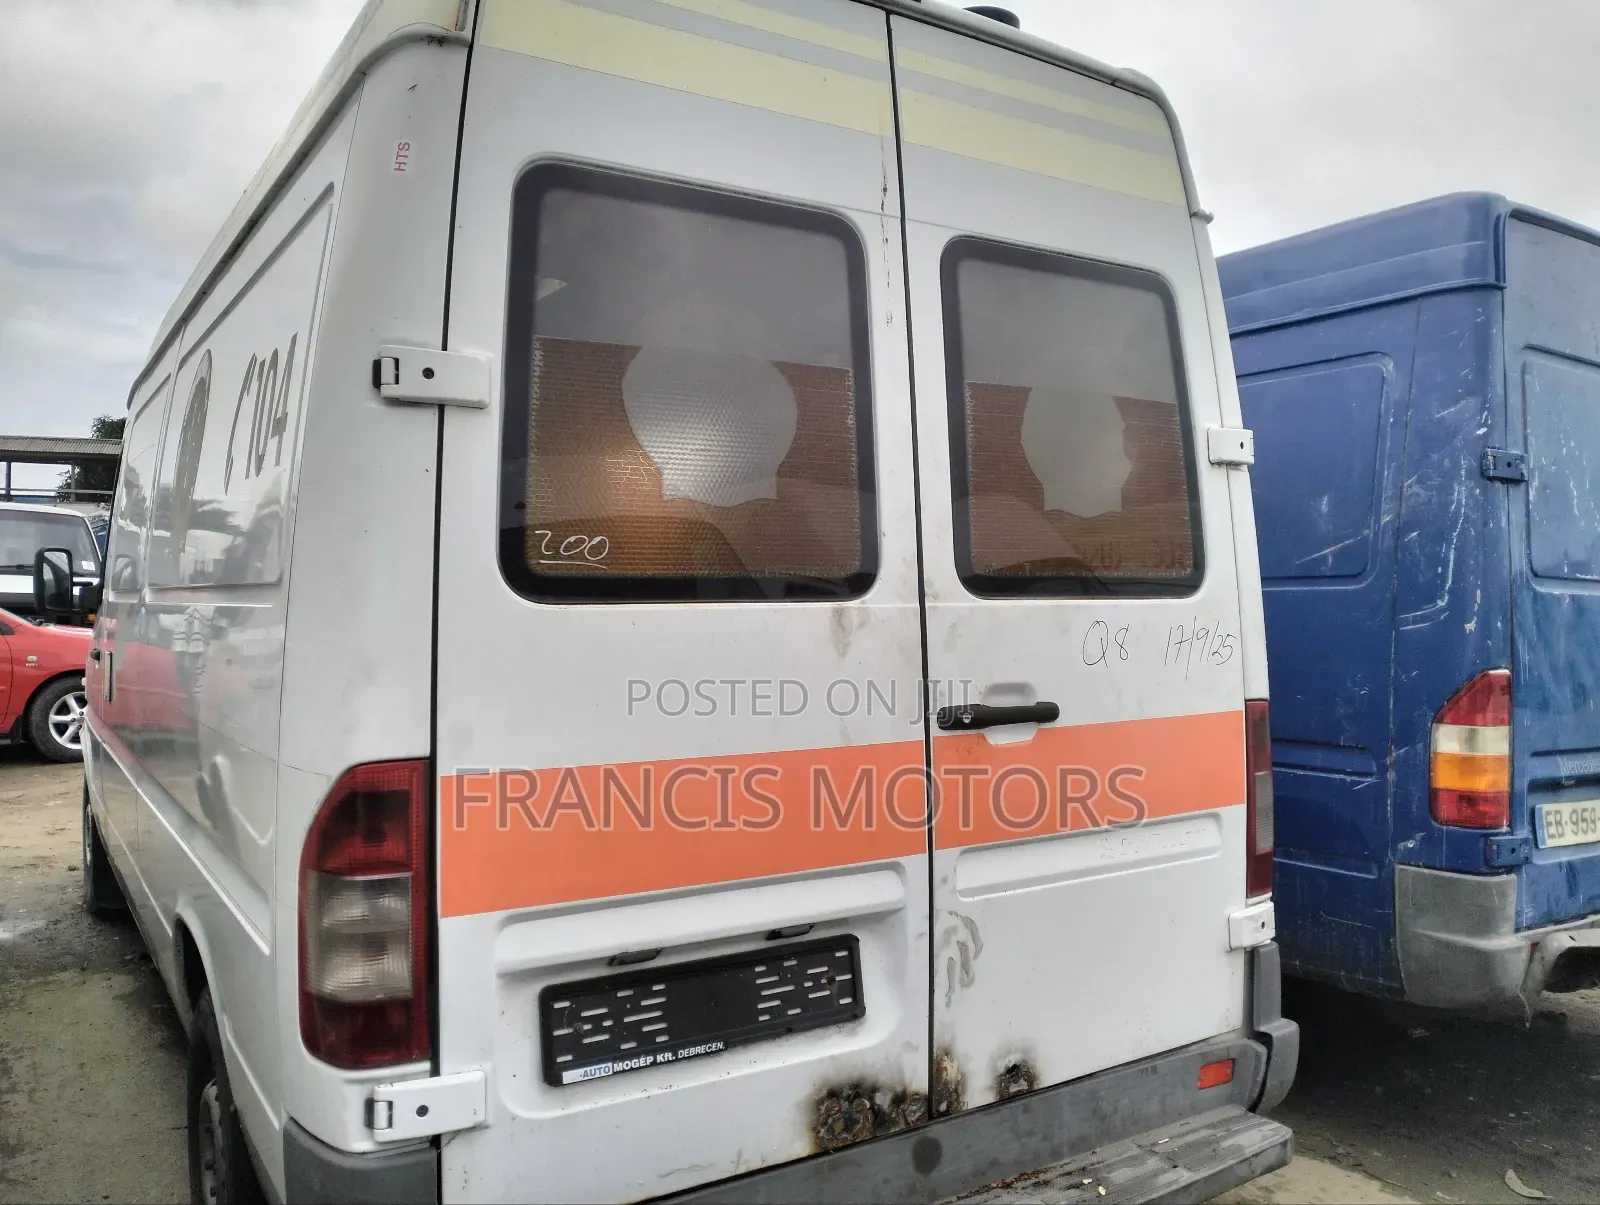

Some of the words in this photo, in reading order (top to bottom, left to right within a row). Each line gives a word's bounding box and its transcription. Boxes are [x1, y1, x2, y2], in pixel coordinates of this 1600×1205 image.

[393, 141, 411, 172] HTS
[244, 332, 298, 481] 104
[535, 530, 609, 561] 200
[613, 1055, 654, 1073] MOGÉP
[656, 1052, 676, 1064] Kft.
